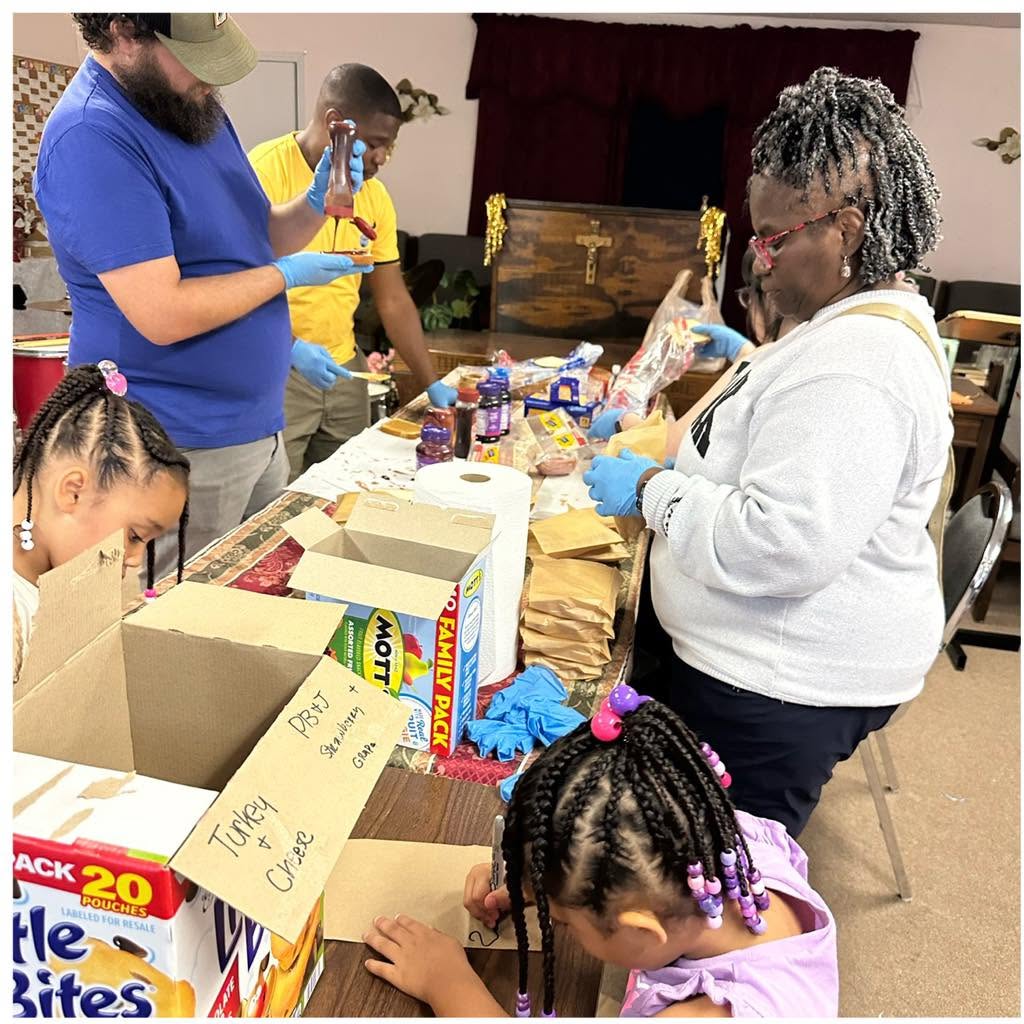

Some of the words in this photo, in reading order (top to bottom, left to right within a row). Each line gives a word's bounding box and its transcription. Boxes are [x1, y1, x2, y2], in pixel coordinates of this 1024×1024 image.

[435, 616, 456, 691] FAMILY
[416, 720, 428, 743] Real
[432, 694, 451, 749] PACK
[207, 794, 279, 858] Turkey
[81, 865, 153, 906] 20
[82, 895, 148, 917] POUCHES
[61, 907, 100, 922] LABELED
[101, 915, 121, 927] FOR
[123, 918, 156, 934] RESALE
